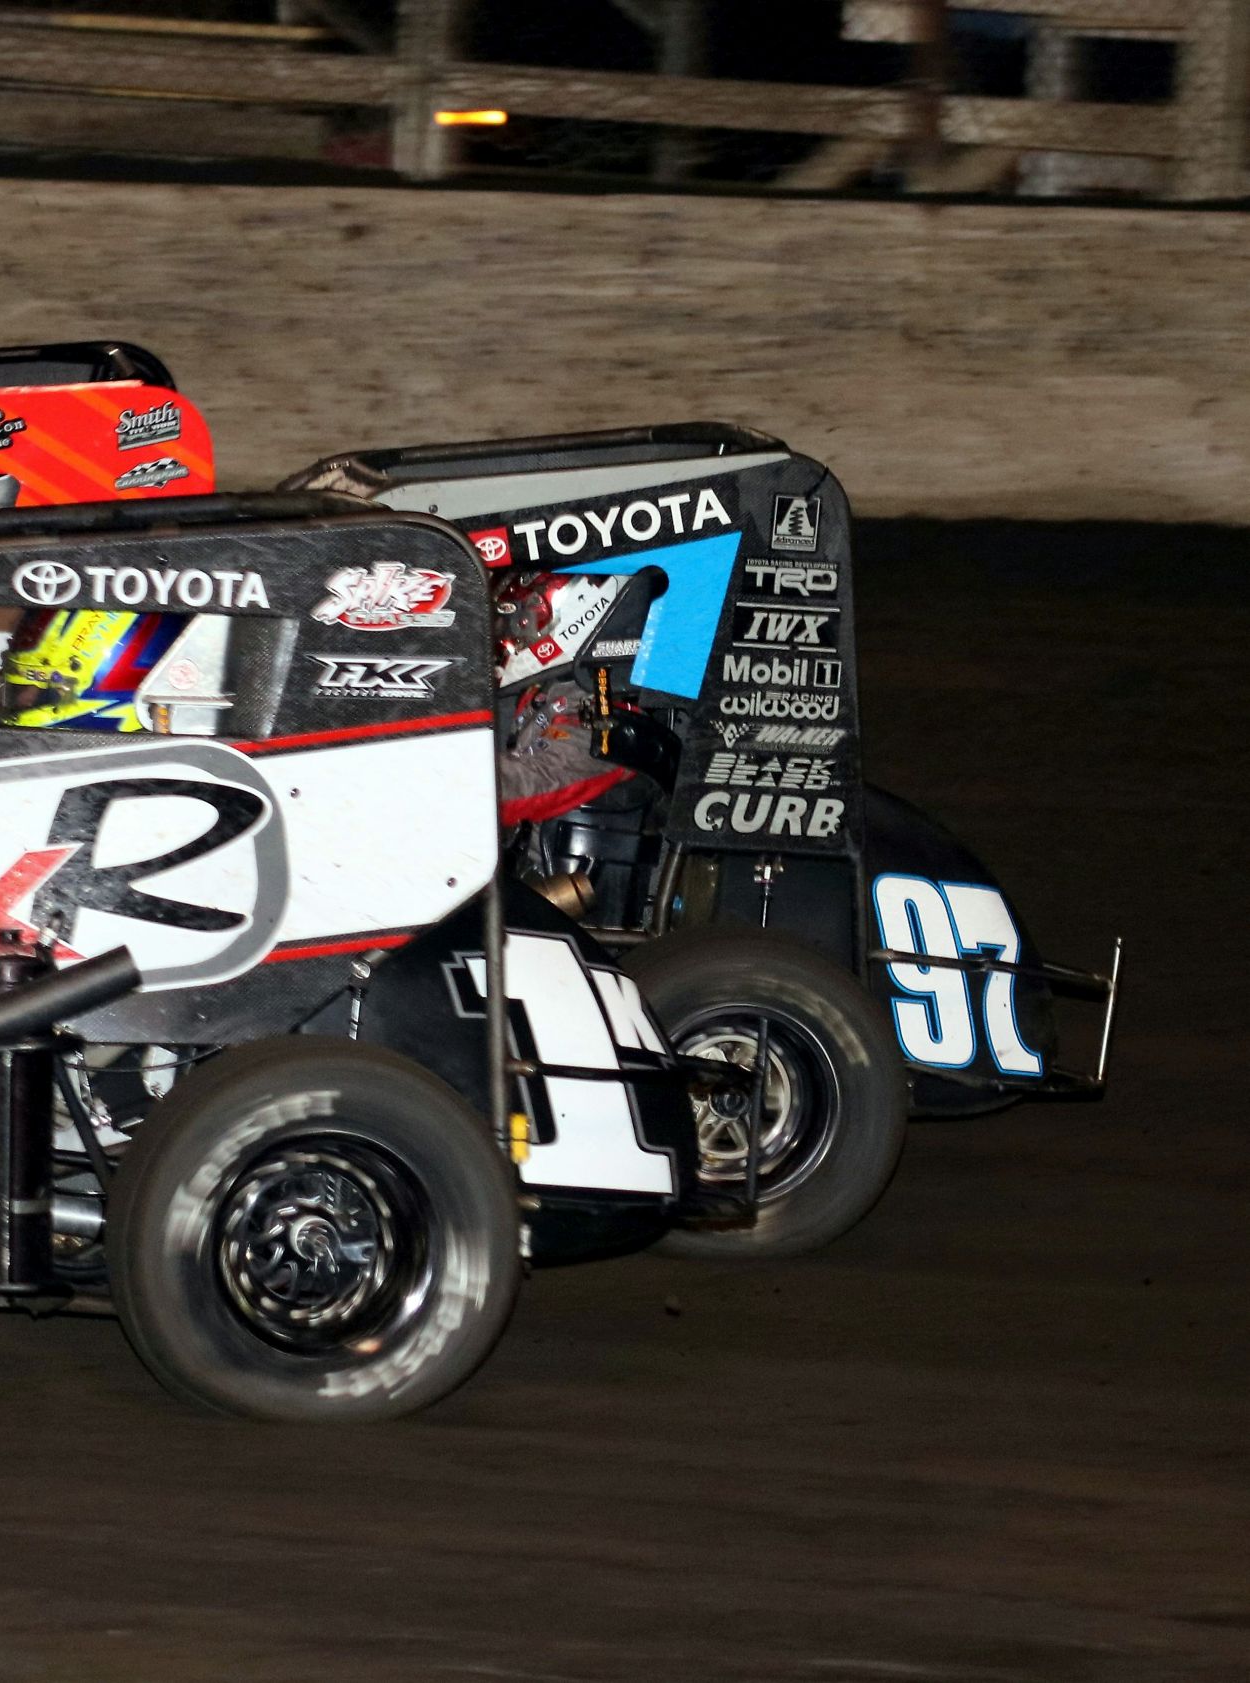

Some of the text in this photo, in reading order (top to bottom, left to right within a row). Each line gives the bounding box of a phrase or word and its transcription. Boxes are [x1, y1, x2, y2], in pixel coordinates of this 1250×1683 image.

[115, 400, 175, 433] Smith
[513, 487, 731, 561] TOYOTA
[747, 558, 770, 566] TOYOTA
[88, 565, 270, 609] TOYOTA
[745, 565, 838, 597] TRD
[558, 597, 610, 641] TOYOTA
[744, 611, 829, 644] IWX
[722, 654, 809, 687] Mobil
[719, 690, 840, 721] wilwood
[782, 692, 834, 703] RACING
[754, 723, 848, 746] WALKER
[693, 790, 846, 838] CURB
[872, 871, 1044, 1078] 97
